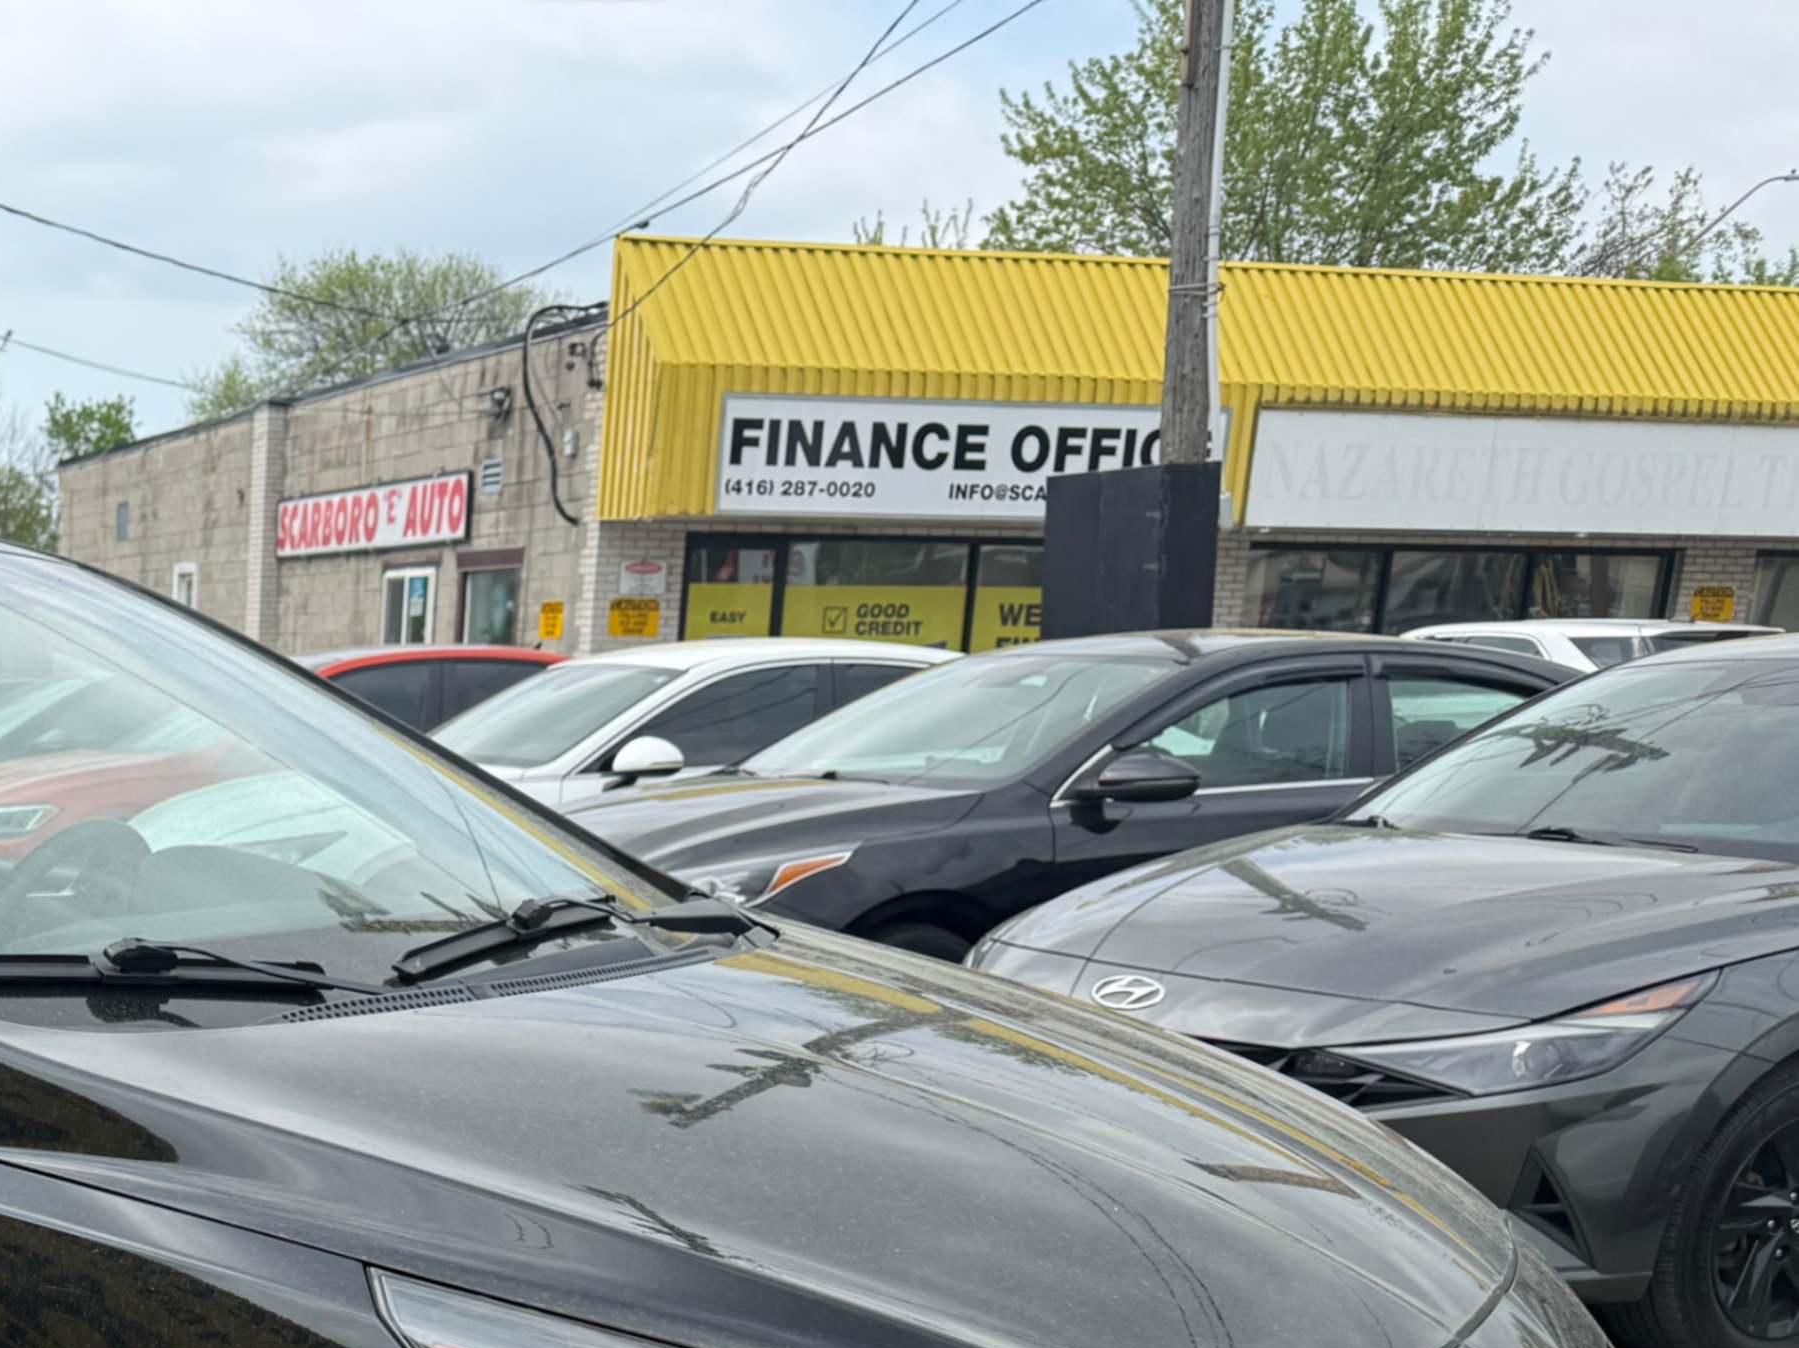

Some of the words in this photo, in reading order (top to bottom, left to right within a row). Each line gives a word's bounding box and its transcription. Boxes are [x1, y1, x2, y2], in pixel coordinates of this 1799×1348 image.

[729, 418, 989, 470] FINANCE
[1010, 424, 1212, 473] OFFI
[724, 479, 774, 496] (416)
[780, 480, 876, 498] 287-0020
[948, 483, 1048, 501] INFO@SCA
[1558, 448, 1743, 510] GOSPEL
[277, 492, 380, 551] SCARBORO
[402, 477, 464, 539] AUTO
[710, 611, 747, 624] EASY
[856, 603, 910, 619] GOOD
[855, 620, 923, 636] CREDIT
